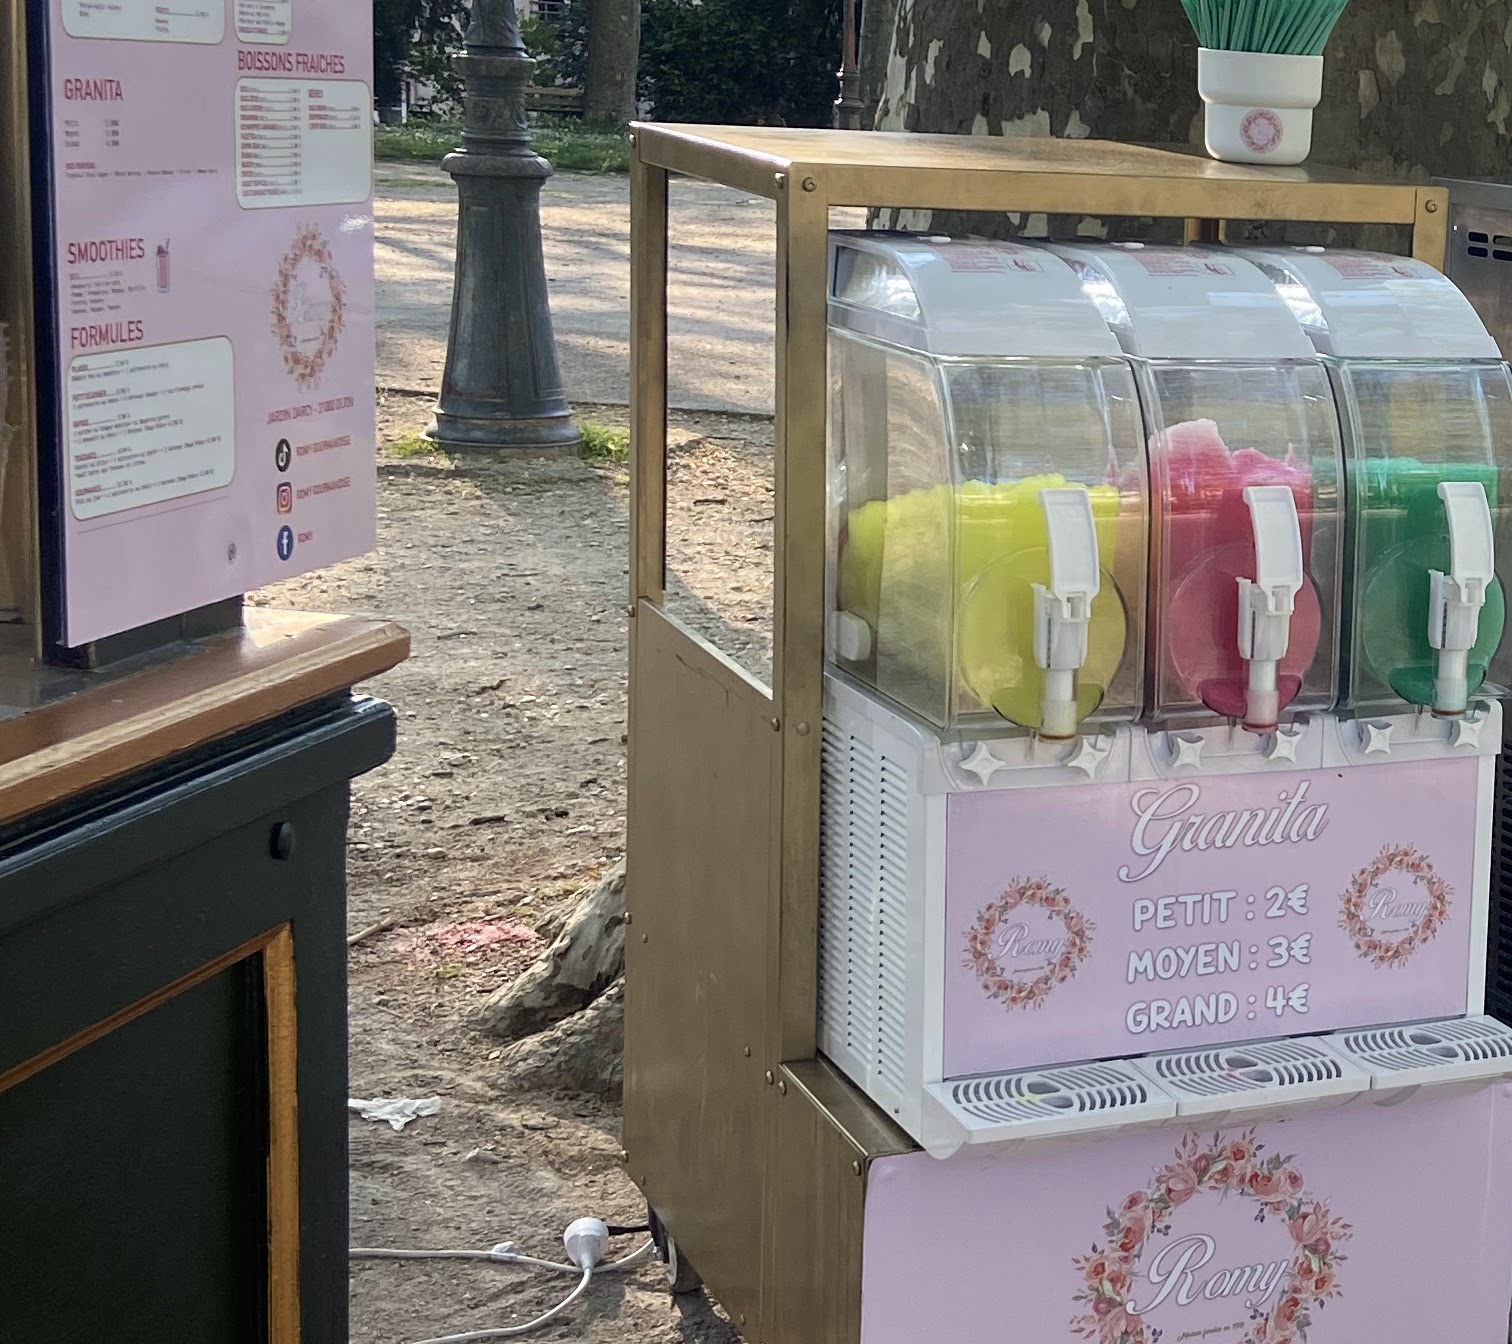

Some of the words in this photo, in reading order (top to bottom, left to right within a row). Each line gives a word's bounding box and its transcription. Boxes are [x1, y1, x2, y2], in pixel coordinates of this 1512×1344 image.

[237, 49, 293, 72] BOISSONS
[296, 52, 345, 74] FRAICHES
[64, 78, 124, 102] GRANITA
[67, 237, 146, 266] SMOOTHIES
[70, 319, 145, 350] FORMULES
[1118, 780, 1330, 884] Granita
[1132, 889, 1238, 932] PETIT
[1264, 882, 1310, 919] 2€
[1360, 887, 1428, 923] Romy
[988, 922, 1065, 961] Romy
[1126, 939, 1241, 985] MOYEN
[1266, 931, 1313, 969] 3€
[1125, 990, 1239, 1035] GRAND
[1264, 982, 1311, 1017] 4€
[1124, 1232, 1293, 1318] Romy
